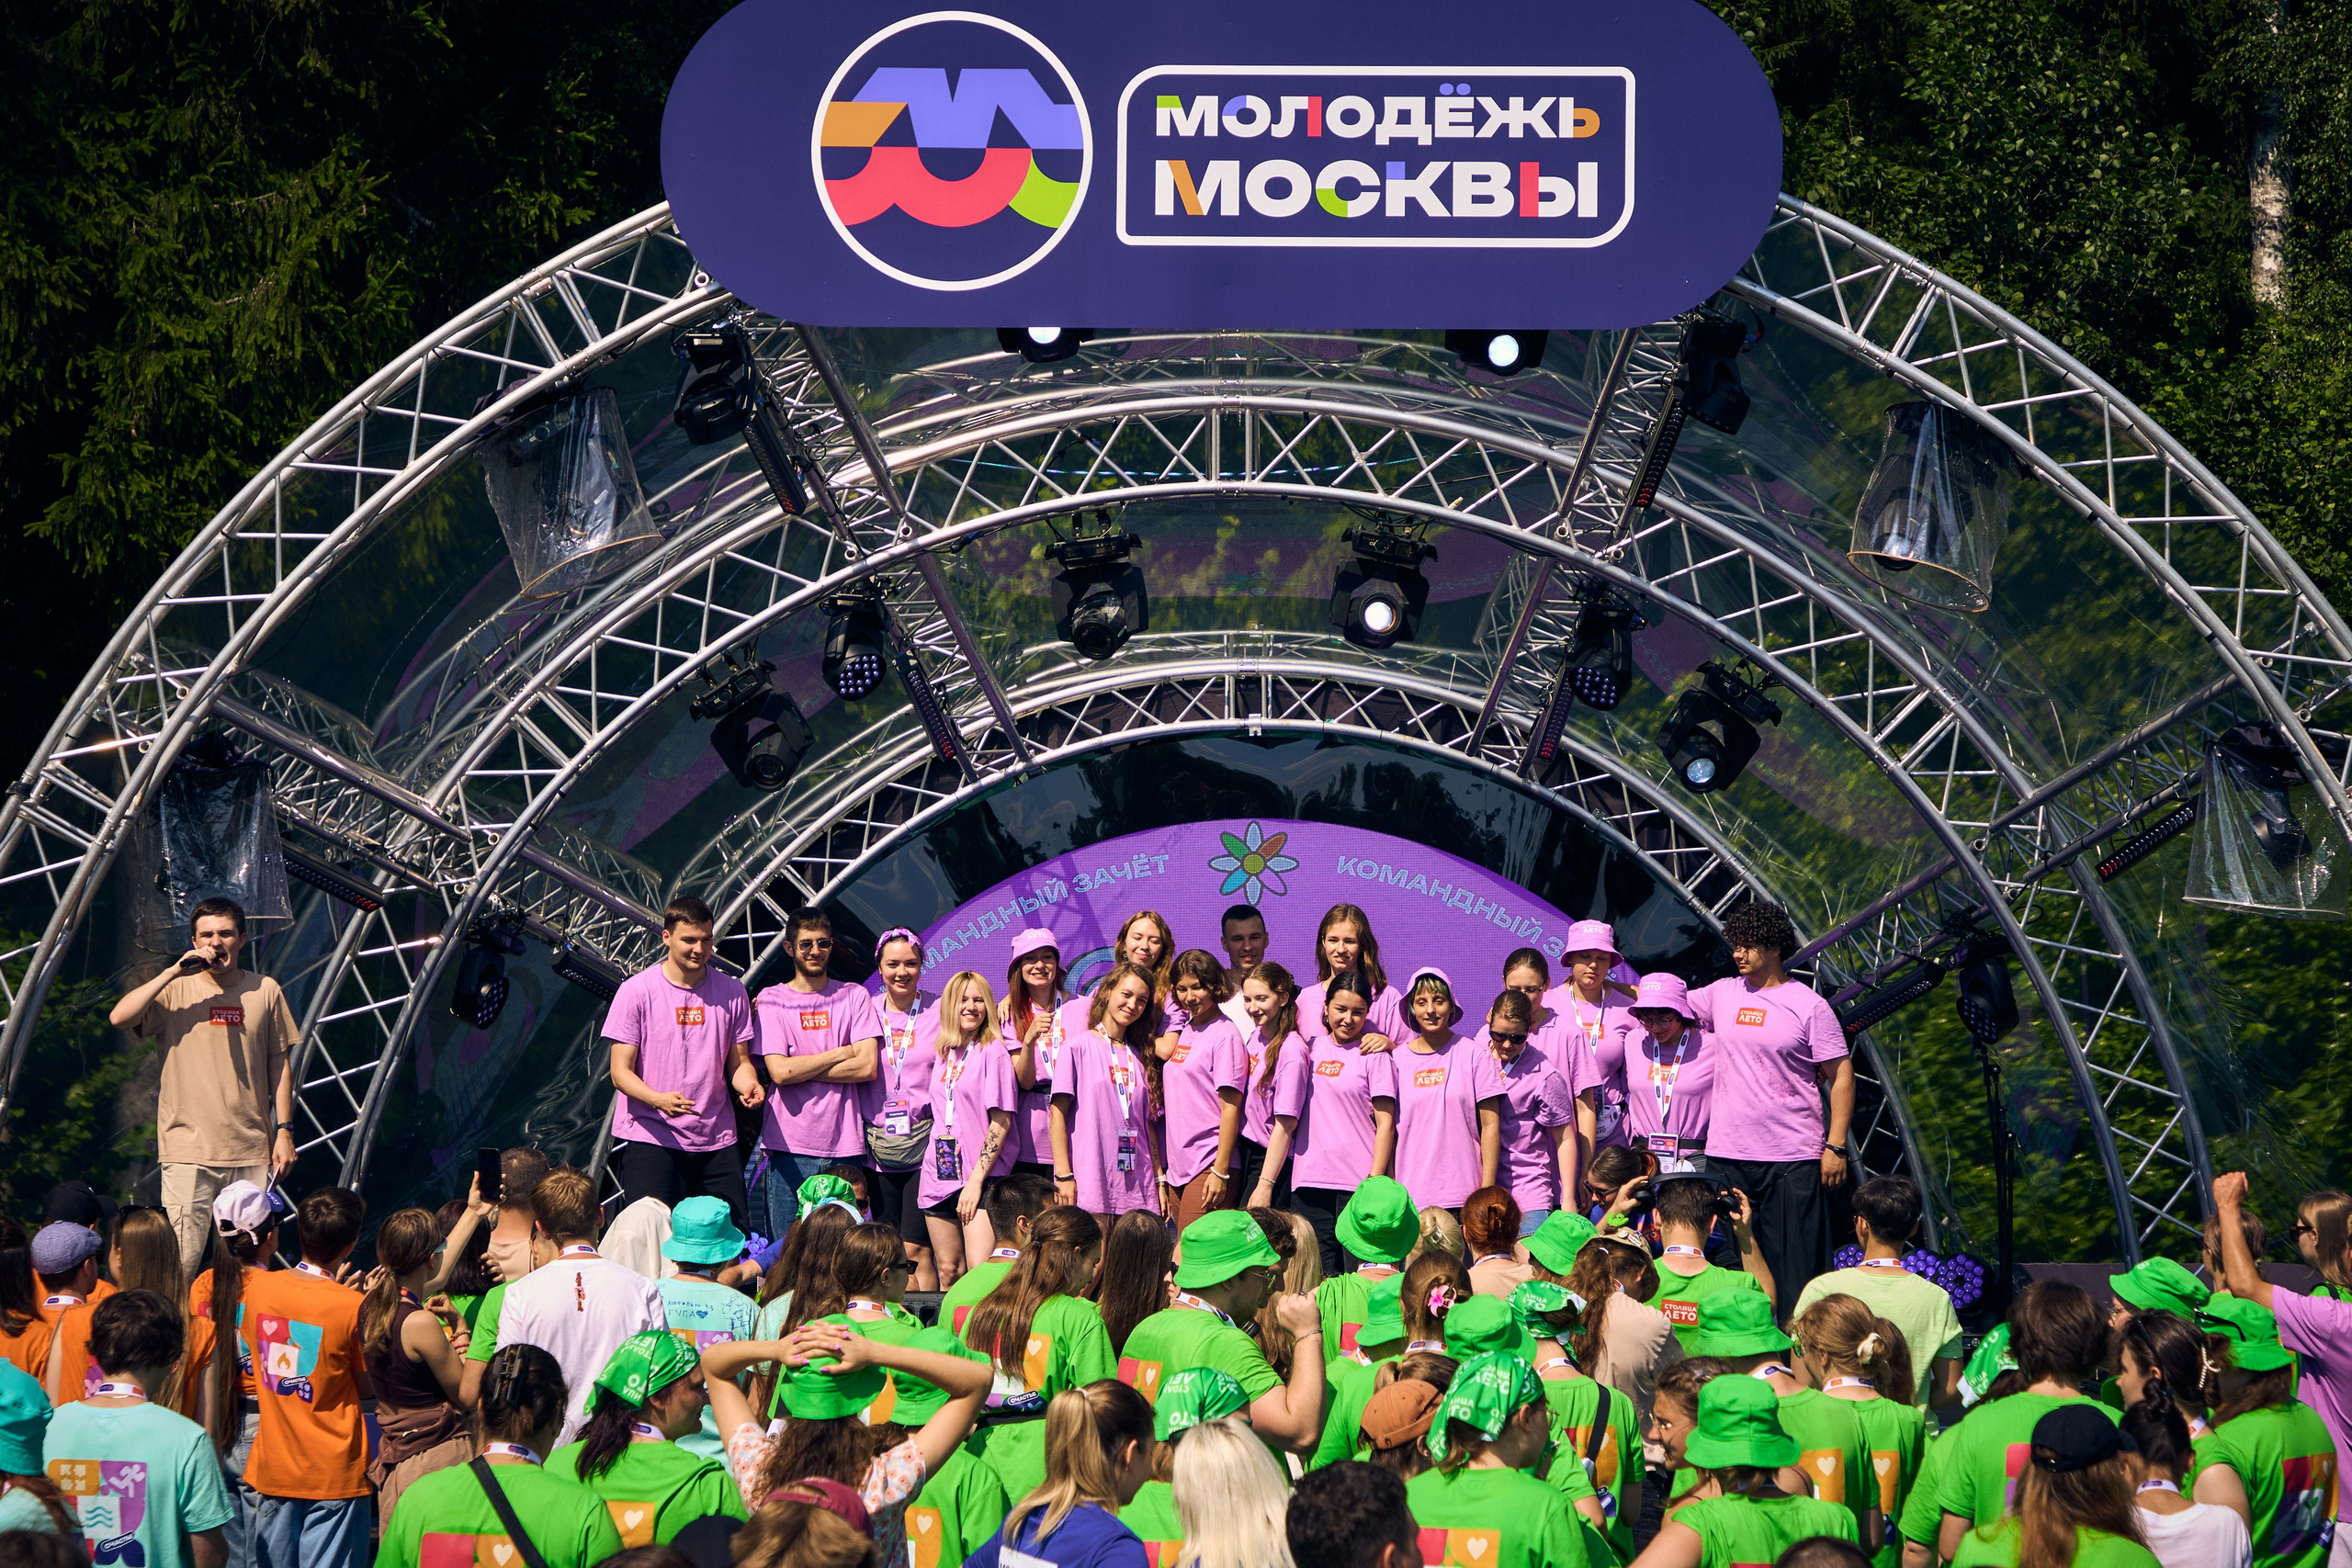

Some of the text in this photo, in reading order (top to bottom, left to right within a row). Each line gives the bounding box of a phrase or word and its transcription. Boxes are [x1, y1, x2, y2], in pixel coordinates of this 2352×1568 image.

[1156, 83, 1600, 145] МОЛОДЁЖЬ
[1155, 159, 1599, 218] МОСКВЫ
[1337, 856, 1544, 944] КОМАНДНЫЙ
[921, 853, 1169, 975] МАНДНЫЙ ЗАЧЁТ
[679, 1014, 702, 1022] ЛЕТО
[1738, 1015, 1763, 1023] ЛЕТО
[802, 1019, 828, 1028] ЛЕТО
[1318, 1066, 1340, 1075] ЛЕТО
[1417, 1076, 1443, 1085] ЛЕТО
[1664, 1303, 1697, 1313] СТОЛИЦА
[1664, 1310, 1697, 1321] ЛЕТО
[1011, 1390, 1037, 1404] СЧАСТЬЕ
